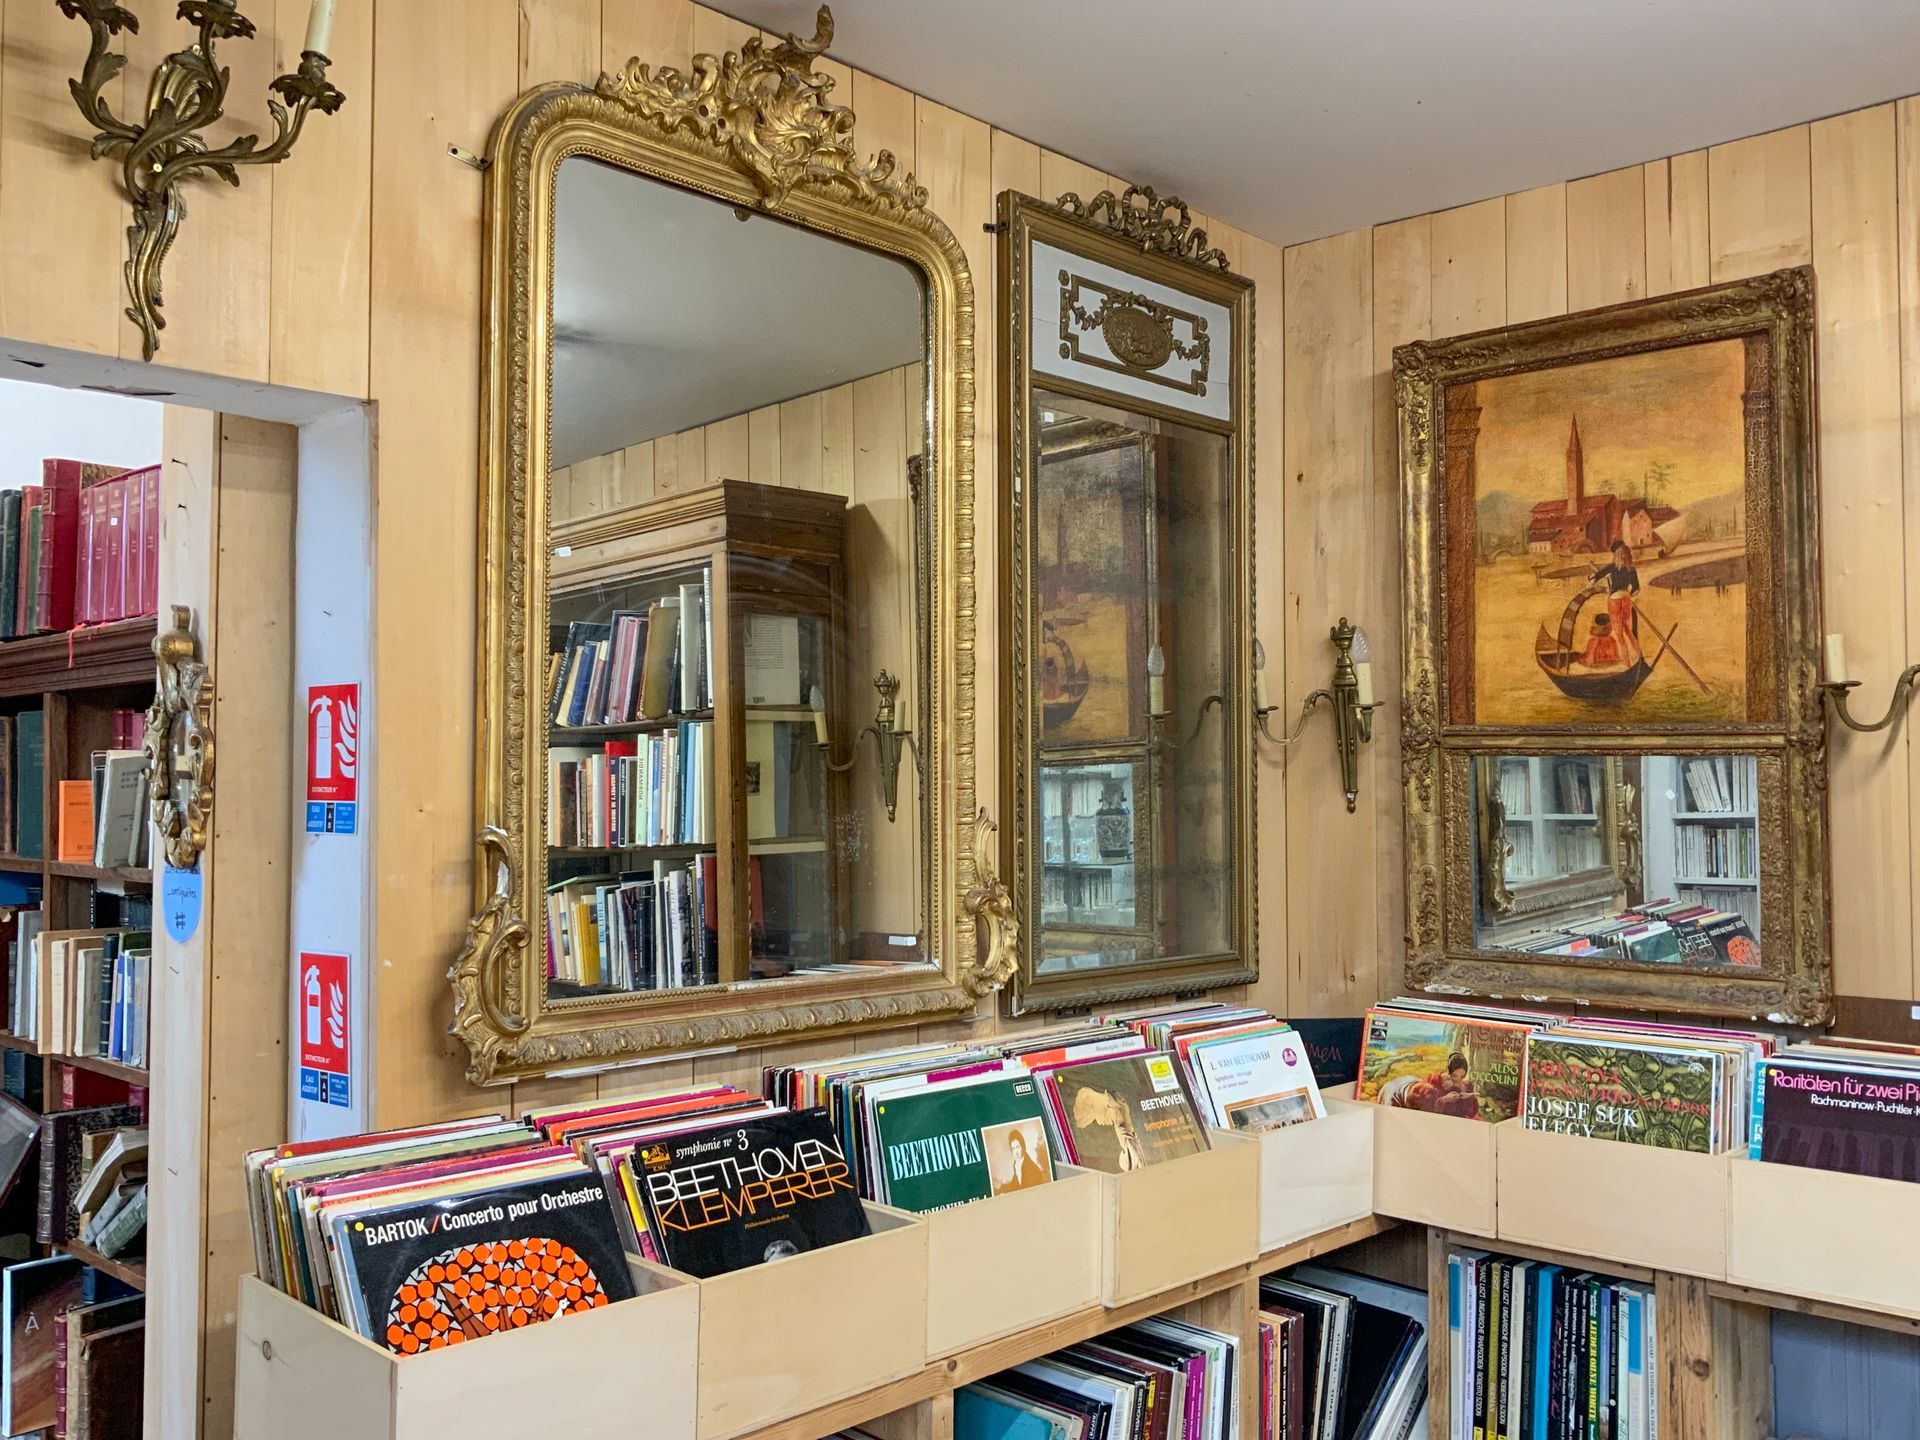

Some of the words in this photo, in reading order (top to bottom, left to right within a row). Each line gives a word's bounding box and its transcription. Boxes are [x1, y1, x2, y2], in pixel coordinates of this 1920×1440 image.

[1218, 1058, 1233, 1068] VAN
[1233, 1050, 1271, 1066] BEETHOVEN
[1489, 1063, 1519, 1075] ALDO
[1015, 1082, 1033, 1094] DECCA
[1470, 1071, 1518, 1086] CICCOLINI
[1773, 1069, 1841, 1094] Raritäten
[1843, 1076, 1863, 1096] für
[1866, 1084, 1904, 1100] zwei
[1140, 1092, 1186, 1112] BEETHOVEN
[1591, 1086, 1633, 1104] TRIO
[1143, 1117, 1178, 1132] Symphonie
[1528, 1096, 1590, 1120] JOSEF
[1595, 1104, 1639, 1128] SUK
[1528, 1116, 1596, 1138] ELEGY
[676, 1137, 722, 1159] symphonie
[736, 1128, 749, 1151] 3
[888, 1129, 982, 1181] BEETHOVEN
[646, 1134, 845, 1206] BEETHOVEN
[655, 1161, 855, 1237] KLEMPERER
[365, 1216, 429, 1246] BARTOK
[441, 1206, 504, 1231] Concerto
[508, 1198, 539, 1221] pour
[540, 1186, 604, 1213] Orchestre
[1478, 1283, 1486, 1299] LISZT
[24, 1311, 40, 1334] À
[1477, 1300, 1485, 1335] UNGARISCHE
[1501, 1306, 1509, 1341] UNGARISCHE
[1476, 1335, 1484, 1370] RHAPSODIEN
[1589, 1320, 1597, 1357] LIEDER
[1500, 1341, 1508, 1377] RHAPSODIEN
[1589, 1357, 1597, 1387] OHNE
[1588, 1387, 1597, 1422] WORTE
